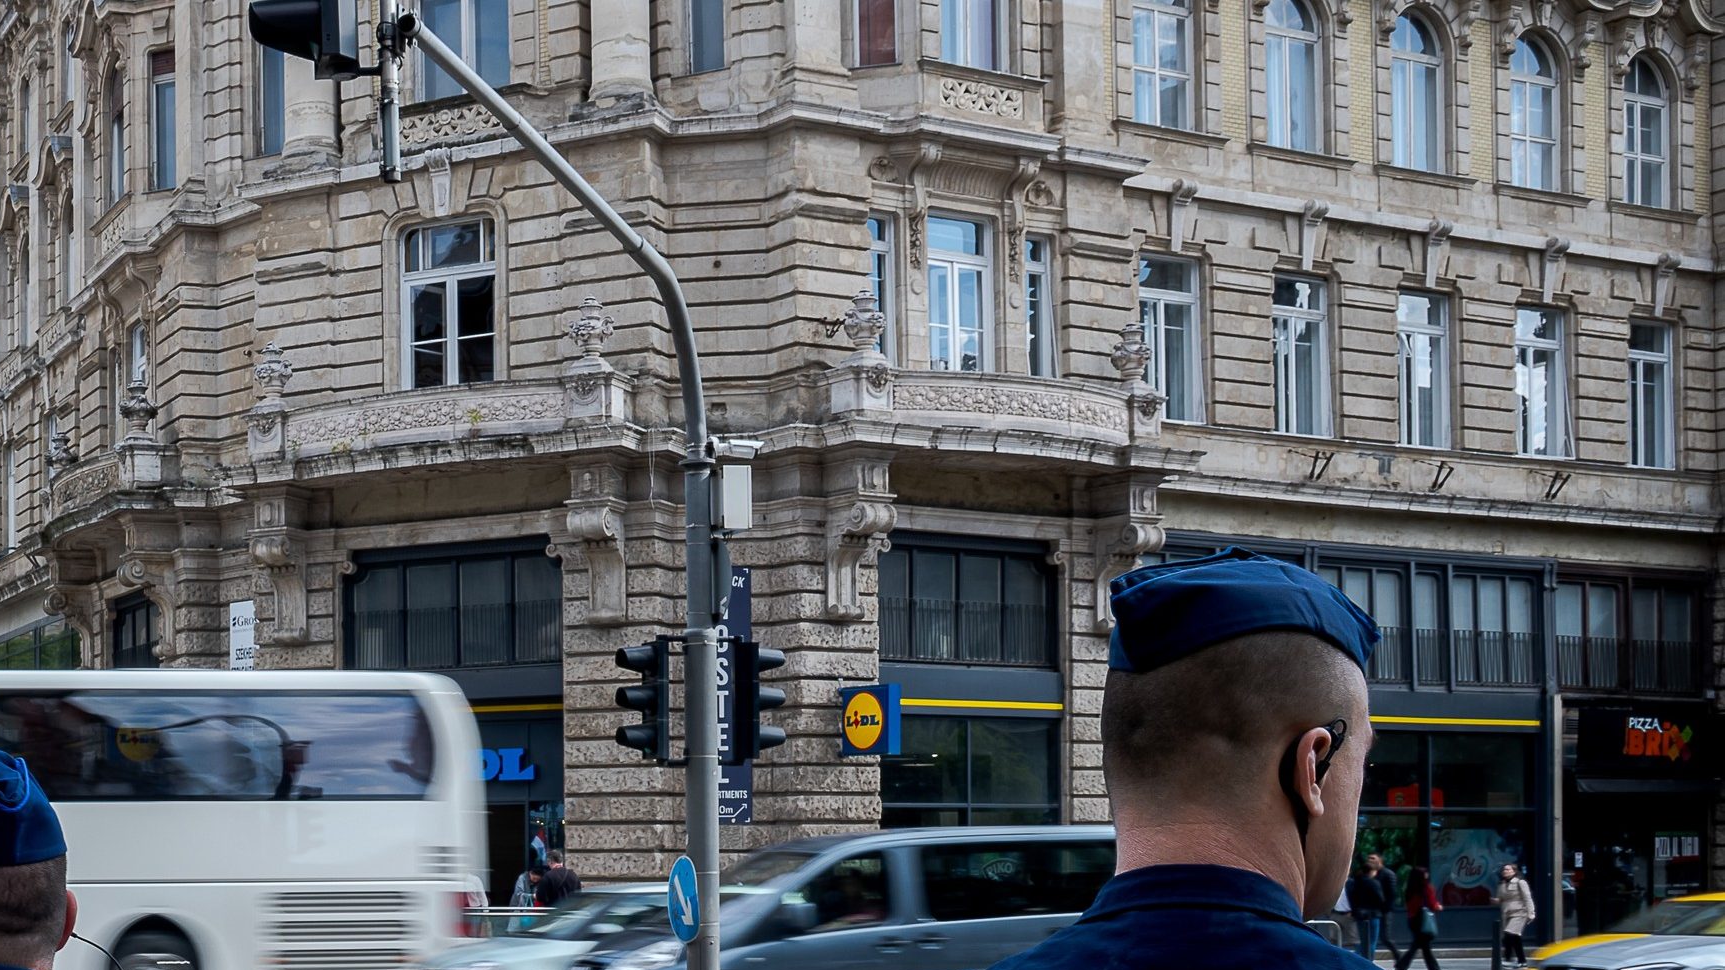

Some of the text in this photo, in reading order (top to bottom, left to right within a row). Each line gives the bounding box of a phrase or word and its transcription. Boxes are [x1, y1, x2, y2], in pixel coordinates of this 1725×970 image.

[846, 710, 880, 728] LIDL
[1628, 717, 1663, 733] PIZZA
[477, 748, 534, 781] DL
[717, 790, 748, 799] RTMENTS
[718, 804, 734, 815] 0m
